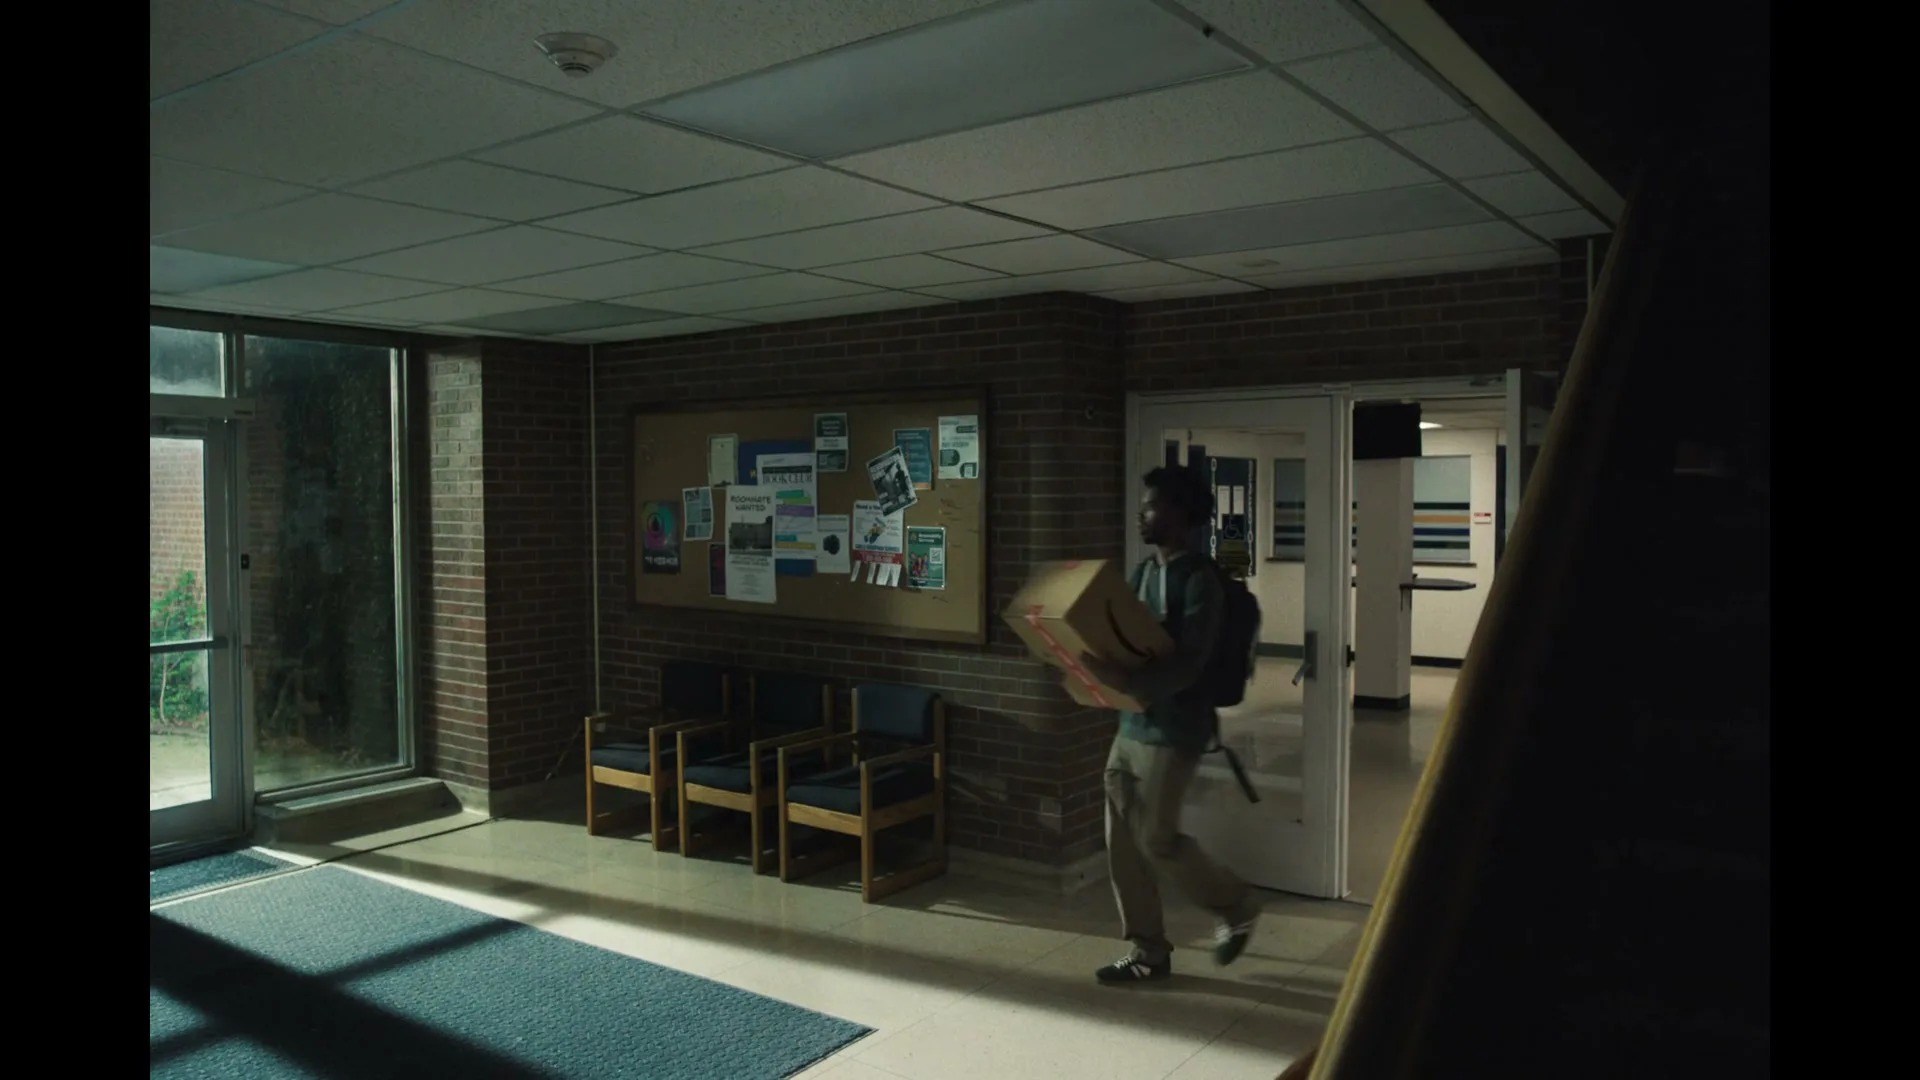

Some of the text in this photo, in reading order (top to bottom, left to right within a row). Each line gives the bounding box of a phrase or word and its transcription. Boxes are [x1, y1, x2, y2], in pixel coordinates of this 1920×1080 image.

[763, 472, 787, 484] BOOK
[788, 471, 812, 483] CLUB
[731, 495, 771, 504] ROOMMATE
[735, 503, 766, 512] WANTED
